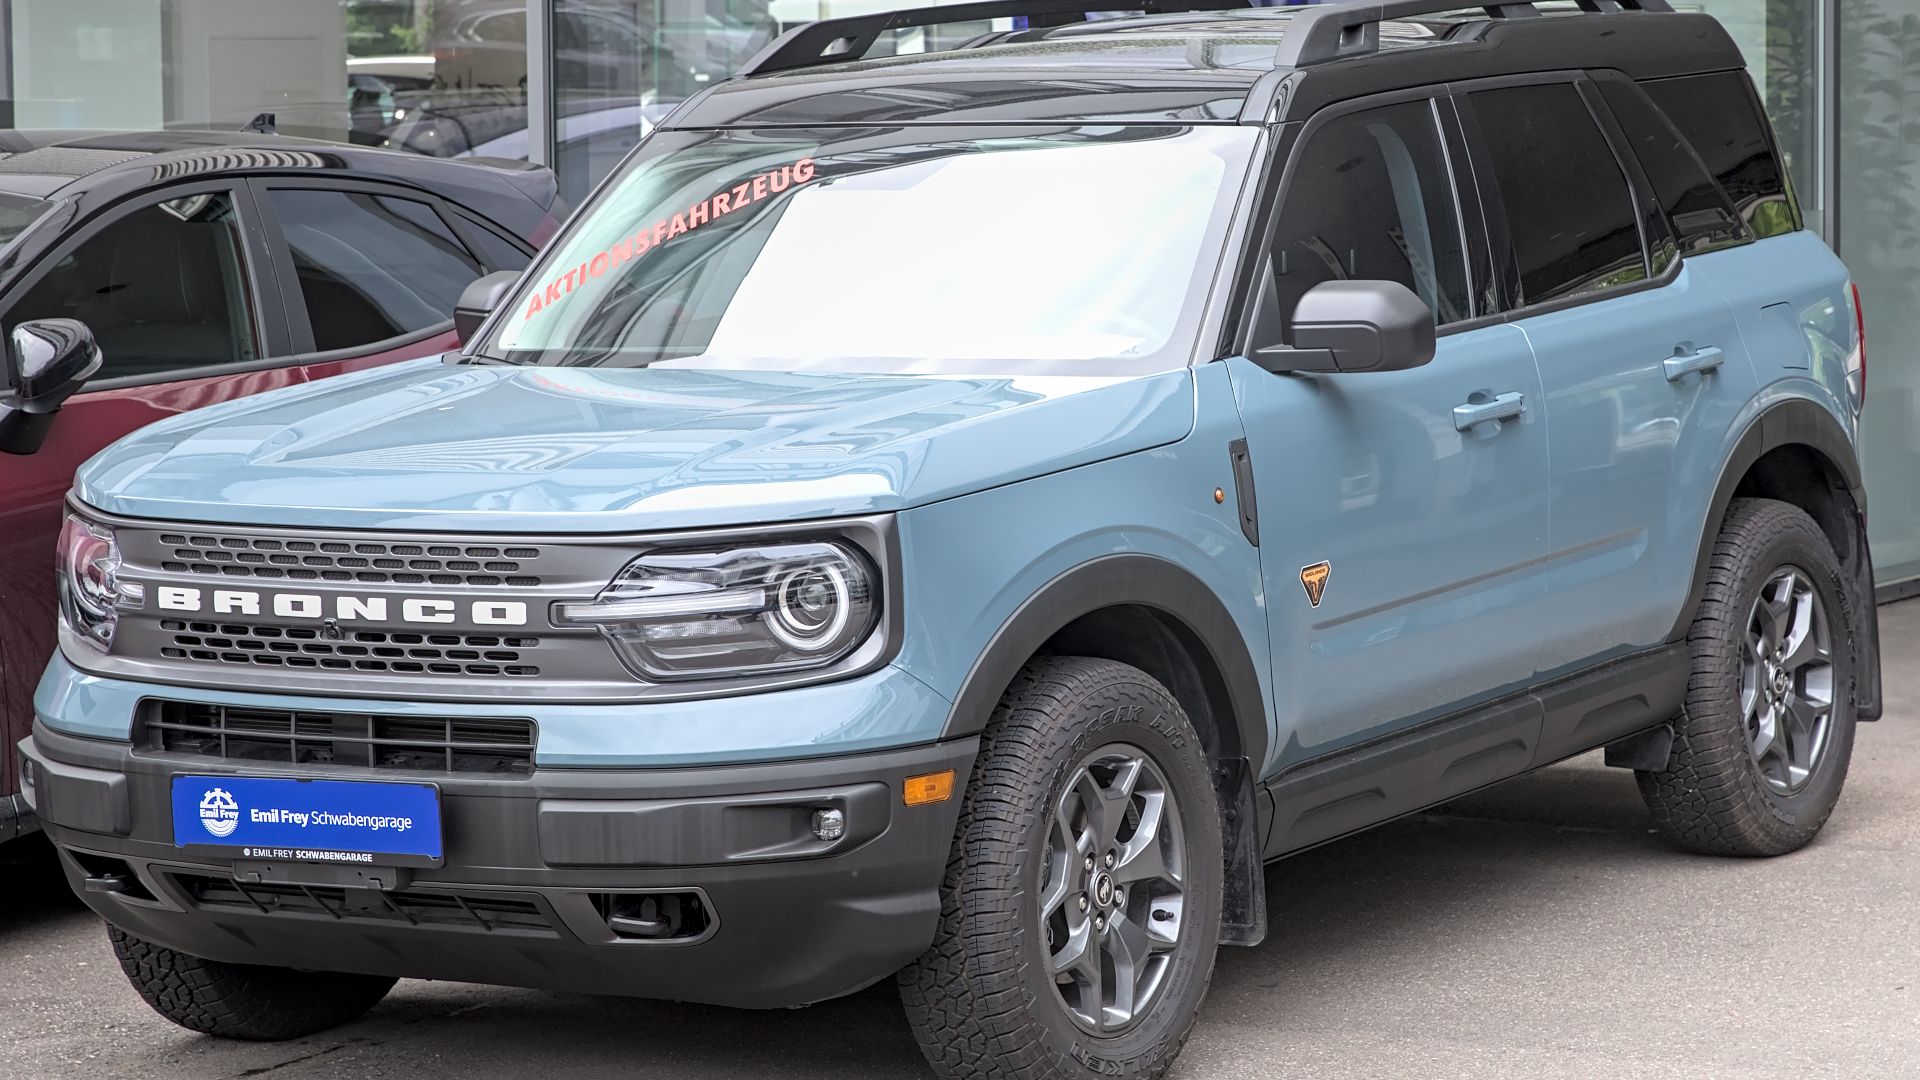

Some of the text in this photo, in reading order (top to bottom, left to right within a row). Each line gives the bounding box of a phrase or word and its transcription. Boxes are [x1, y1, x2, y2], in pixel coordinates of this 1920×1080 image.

[525, 157, 816, 320] AKTIONSFAHRZEUG
[158, 586, 527, 625] BRONCO
[200, 808, 239, 821] Emil Frey
[250, 808, 412, 832] Emil Frey Schwabengarage
[252, 848, 373, 863] EMIL FREY SCHWABENGARAGE
